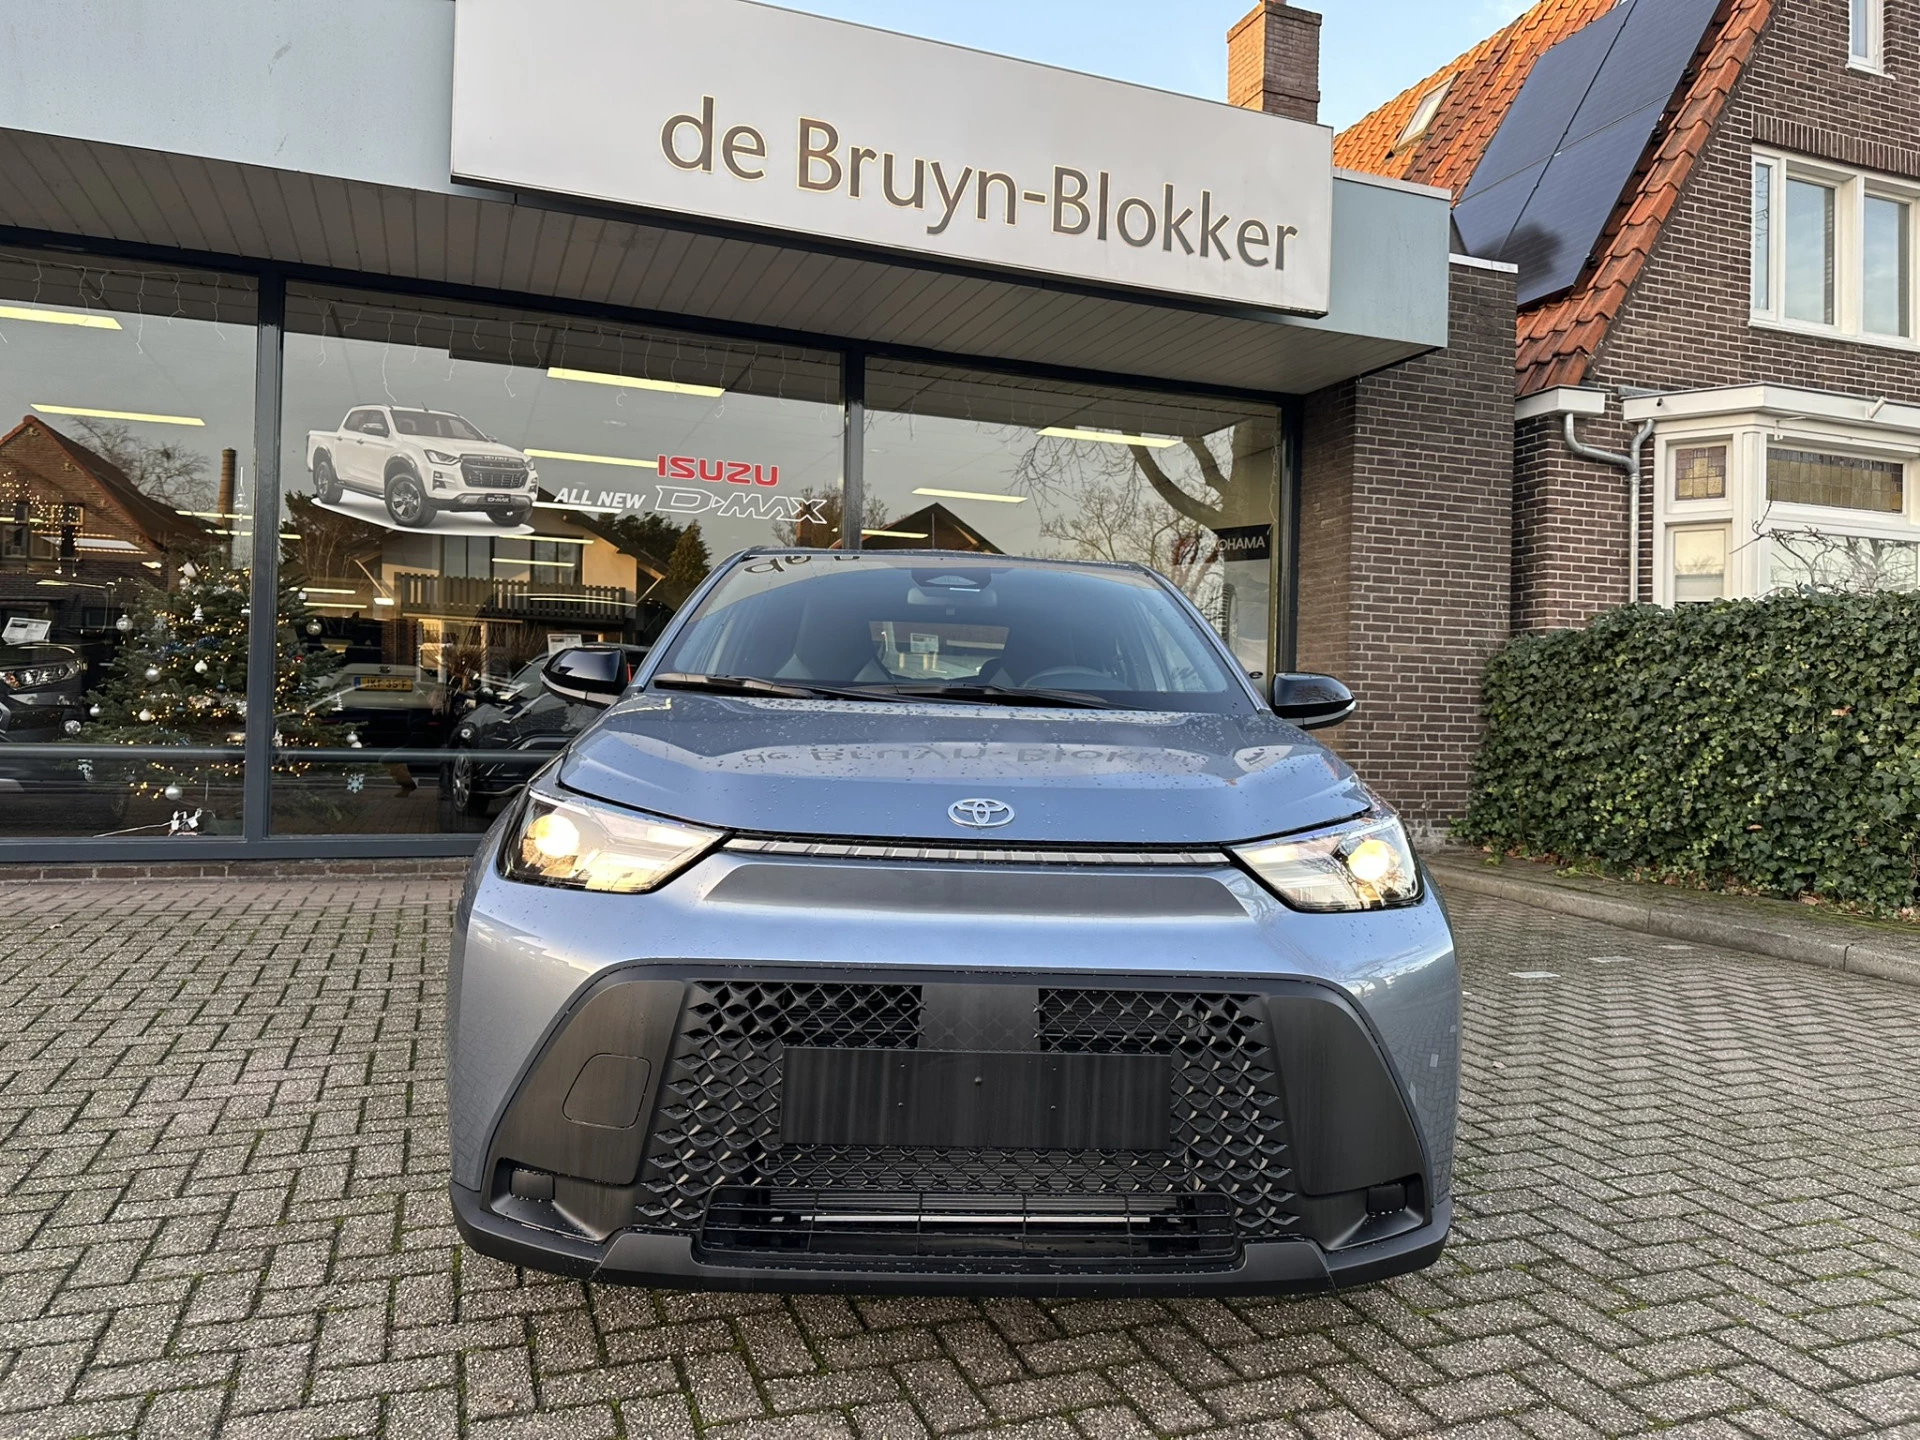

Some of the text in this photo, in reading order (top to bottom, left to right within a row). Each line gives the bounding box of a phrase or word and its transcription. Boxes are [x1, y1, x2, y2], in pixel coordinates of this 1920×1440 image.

[660, 95, 1298, 271] de Bruyn-Blokker
[657, 454, 780, 488] ISUZU
[554, 487, 592, 506] ALL
[597, 491, 647, 509] NEW
[1197, 535, 1266, 552] OHAMA
